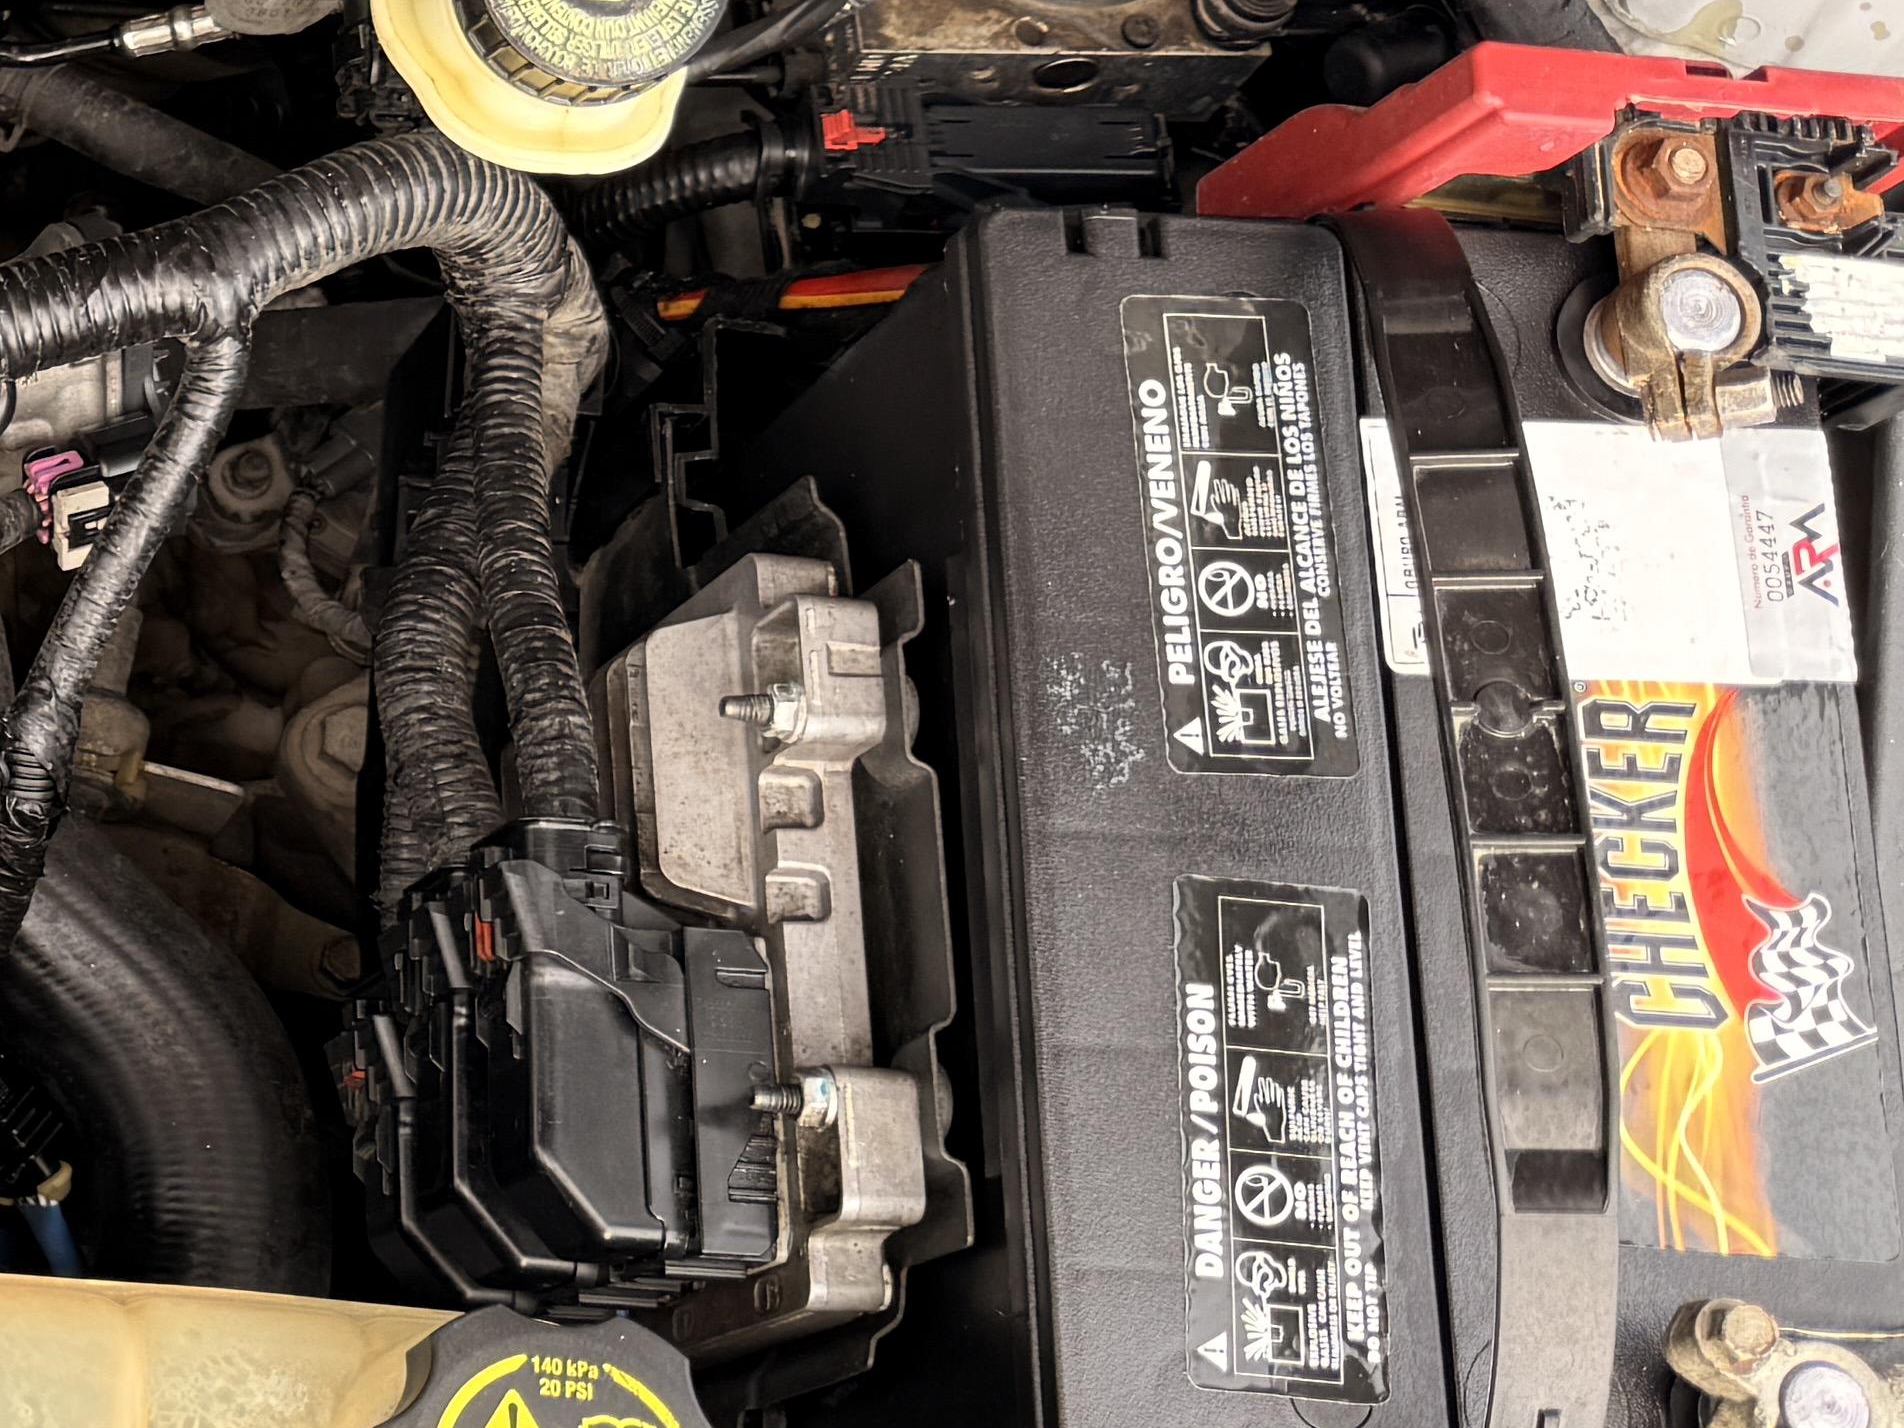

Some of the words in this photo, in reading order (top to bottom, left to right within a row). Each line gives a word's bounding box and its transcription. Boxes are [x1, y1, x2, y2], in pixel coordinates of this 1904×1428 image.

[1272, 352, 1294, 420] NIÑOS
[1292, 362, 1312, 429] TAPONES
[1279, 424, 1300, 461] LOS
[1298, 433, 1316, 461] LOS
[1286, 469, 1306, 496] DE
[1303, 464, 1322, 516] FIRMES
[1290, 502, 1316, 594] ALCANCE
[1310, 519, 1330, 598] CONSERVE
[1747, 546, 1758, 560] de
[1756, 510, 1784, 602] 0054447
[1255, 574, 1268, 609] NO
[1302, 597, 1322, 636] DEL
[1306, 640, 1332, 722] ALEJESE
[1326, 642, 1344, 709] VOLTEAR
[1334, 712, 1348, 738] NO
[1579, 695, 1729, 1031] CHECKER
[1347, 930, 1363, 978] LEVEL
[1330, 956, 1353, 1068] CHILDREN
[1350, 984, 1366, 1019] AND
[1352, 1022, 1368, 1072] TIGHT
[1337, 1072, 1355, 1104] OF
[1354, 1076, 1370, 1118] CAPS
[1338, 1112, 1358, 1185] REACH
[1357, 1121, 1372, 1164] VENT
[1294, 1180, 1308, 1220] NO
[1340, 1189, 1359, 1222] OF
[1359, 1168, 1374, 1210] KEEP
[1344, 1226, 1362, 1276] OUT
[1346, 1282, 1364, 1341] KEEP
[1366, 1296, 1380, 1331] NOT
[531, 1355, 562, 1376] 140
[566, 1357, 599, 1380] kPa
[539, 1379, 561, 1397] 20
[564, 1380, 593, 1401] PSI
